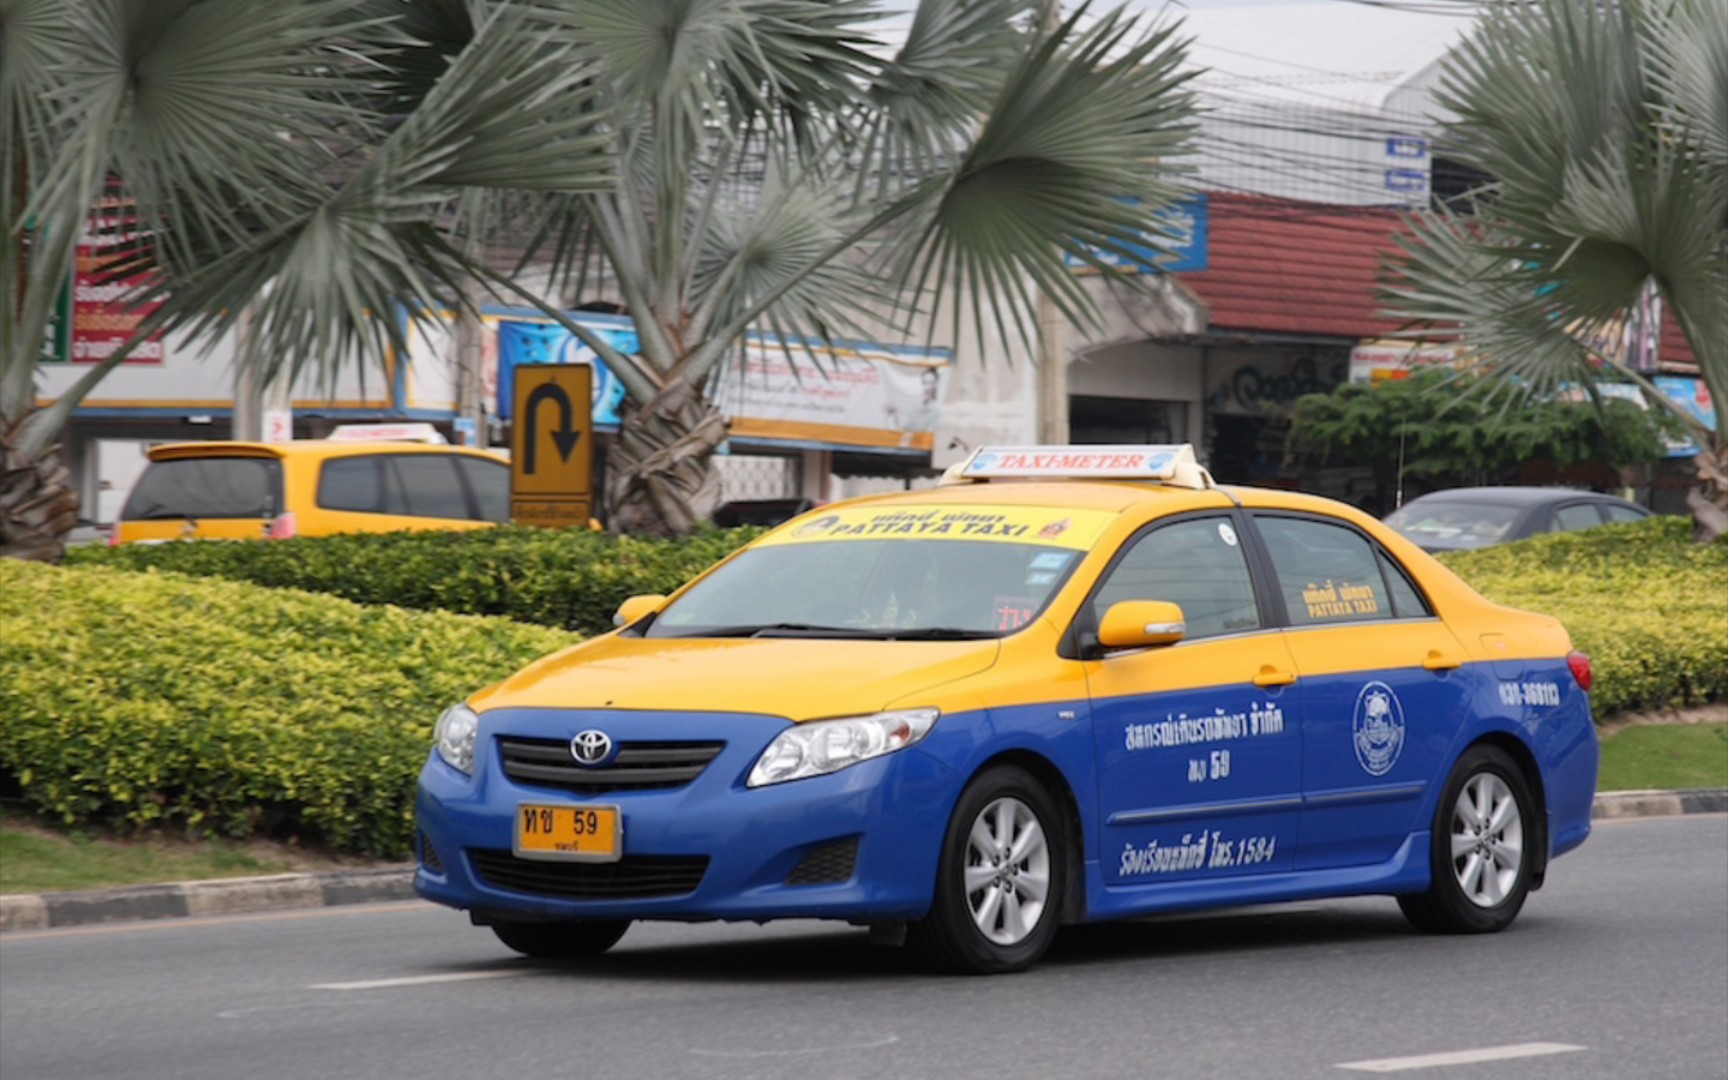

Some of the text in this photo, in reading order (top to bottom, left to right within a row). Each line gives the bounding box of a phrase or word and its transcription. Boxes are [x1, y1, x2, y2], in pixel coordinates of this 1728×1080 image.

[999, 453, 1145, 469] TAXI-METER
[830, 522, 1029, 537] PATTAYA TAXI
[1308, 598, 1378, 618] PATTAYA TAXI
[1210, 749, 1231, 780] 59
[573, 810, 598, 835] 59
